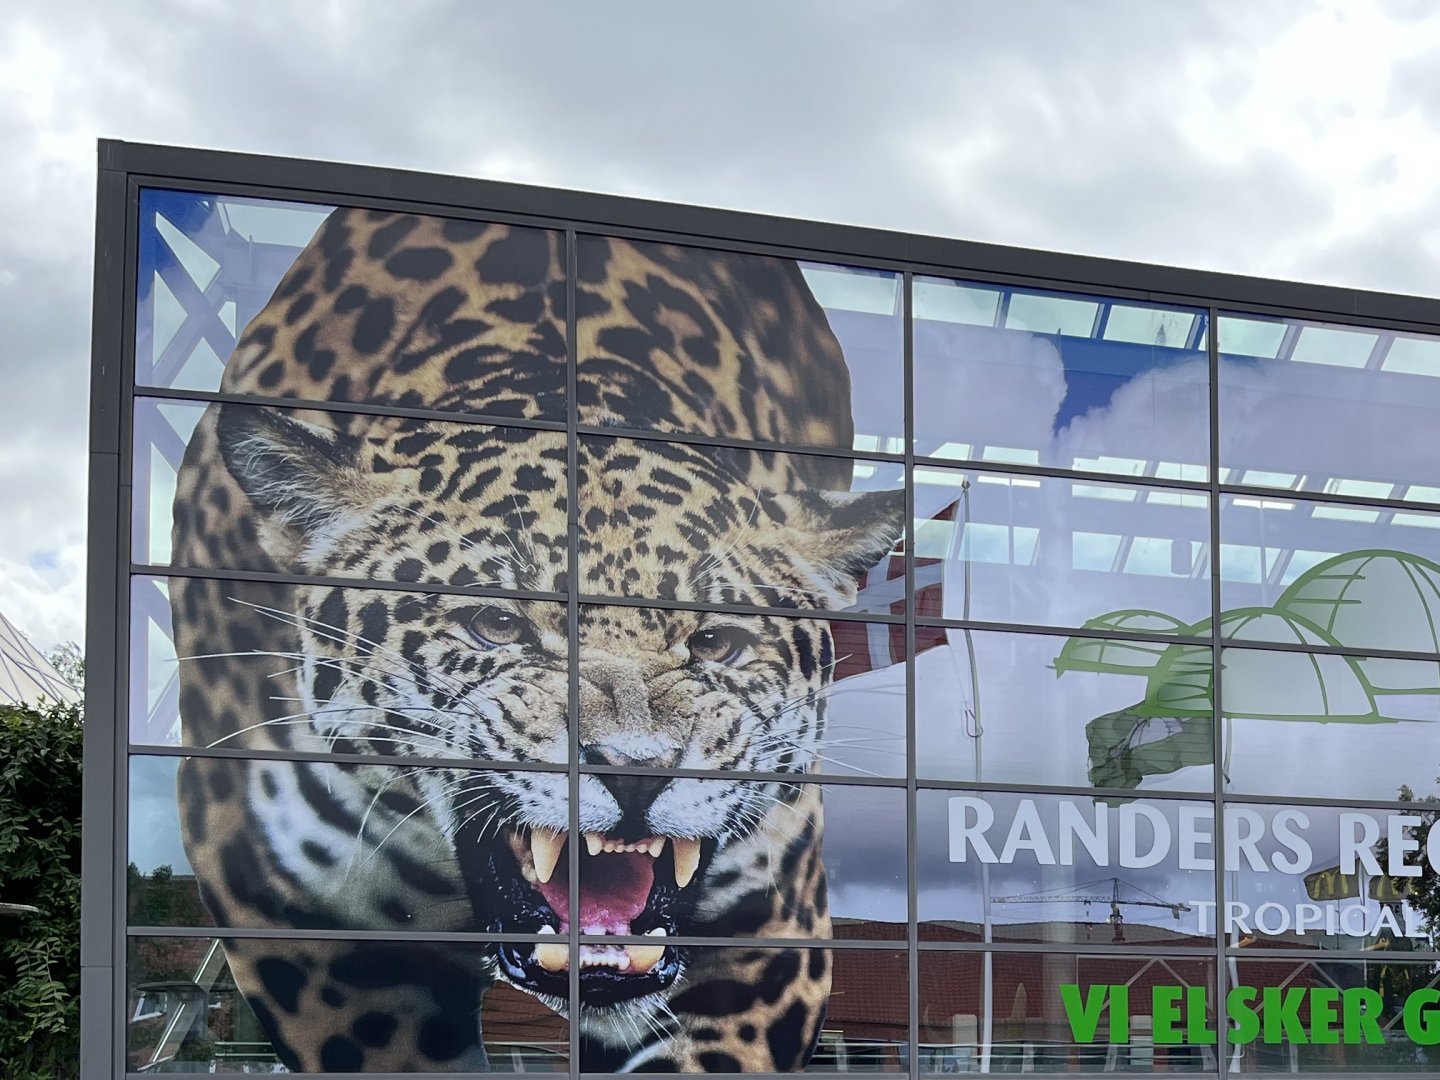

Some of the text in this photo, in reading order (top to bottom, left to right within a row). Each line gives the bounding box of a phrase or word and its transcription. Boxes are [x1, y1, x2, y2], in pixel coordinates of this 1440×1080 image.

[948, 796, 1313, 875] RANDERS
[1188, 900, 1430, 939] TROPICAL
[1059, 984, 1129, 1043] VI
[1152, 985, 1386, 1044] ELSKER
